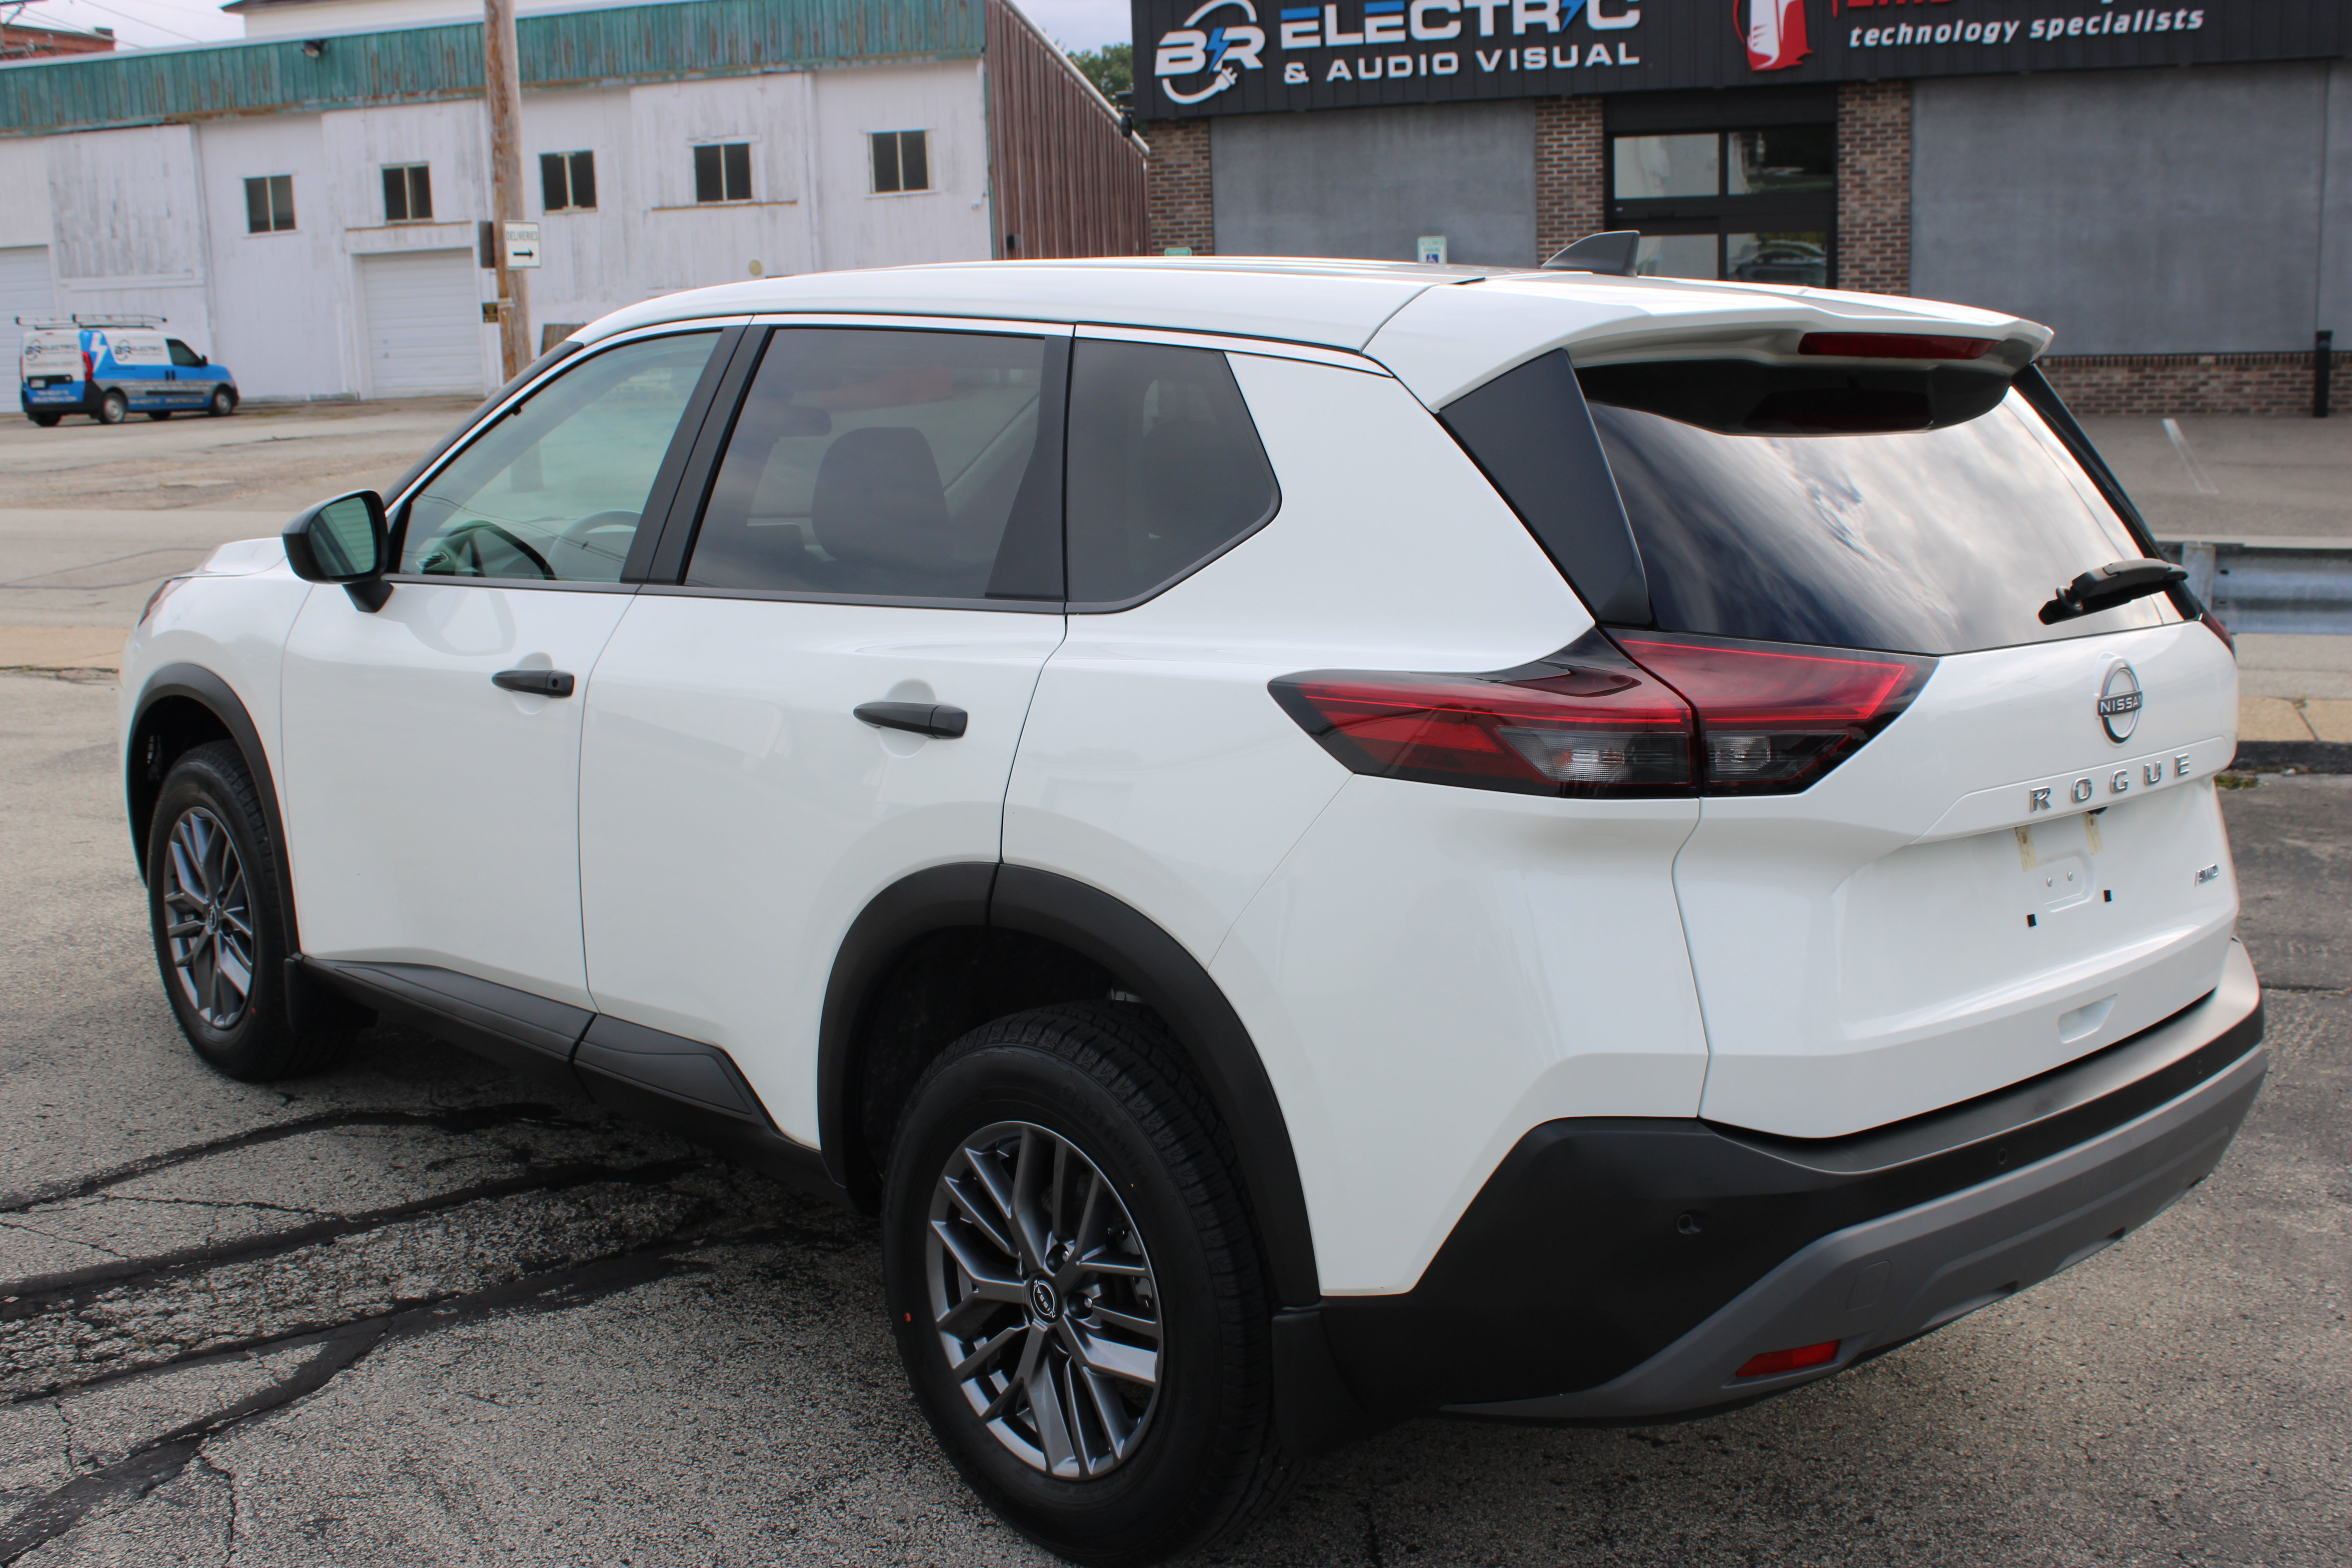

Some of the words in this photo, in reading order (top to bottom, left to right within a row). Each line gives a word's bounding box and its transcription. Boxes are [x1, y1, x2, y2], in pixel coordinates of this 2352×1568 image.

[1281, 0, 1640, 49] ELECTRIC
[1849, 19, 2020, 48] technology
[2029, 8, 2205, 41] specialists
[1284, 62, 1309, 84] &
[1326, 52, 1458, 82] AUDIO
[1475, 42, 1640, 72] VISUAL
[506, 231, 538, 240] DELIVERIES
[2030, 753, 2190, 813] ROGUE
[1033, 1279, 1056, 1319] NISSAN
